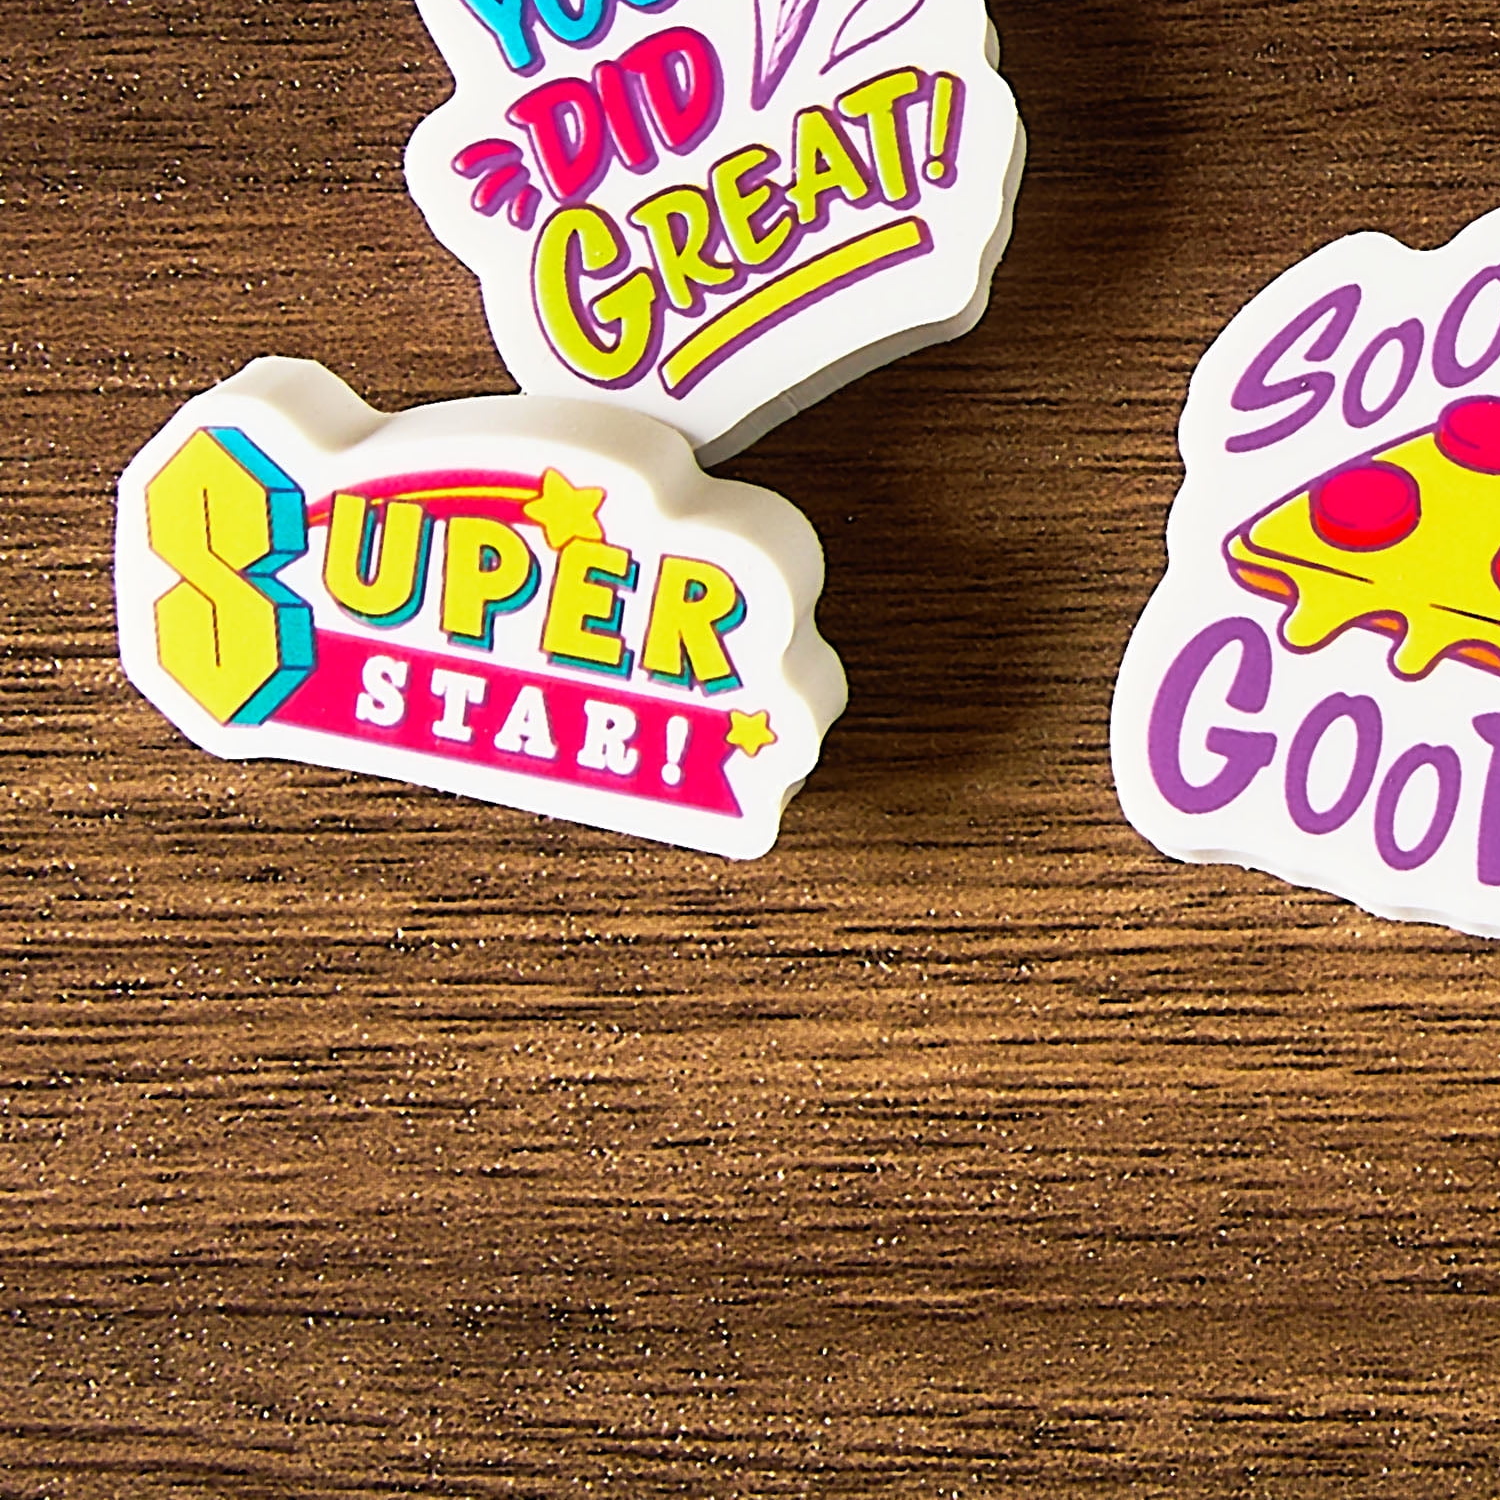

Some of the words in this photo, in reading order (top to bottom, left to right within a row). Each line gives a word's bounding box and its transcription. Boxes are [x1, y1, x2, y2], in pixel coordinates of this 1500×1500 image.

[506, 26, 722, 205] DID
[531, 66, 965, 390] GREAT!
[146, 426, 746, 726] SUPER
[355, 655, 691, 787] STAR!
